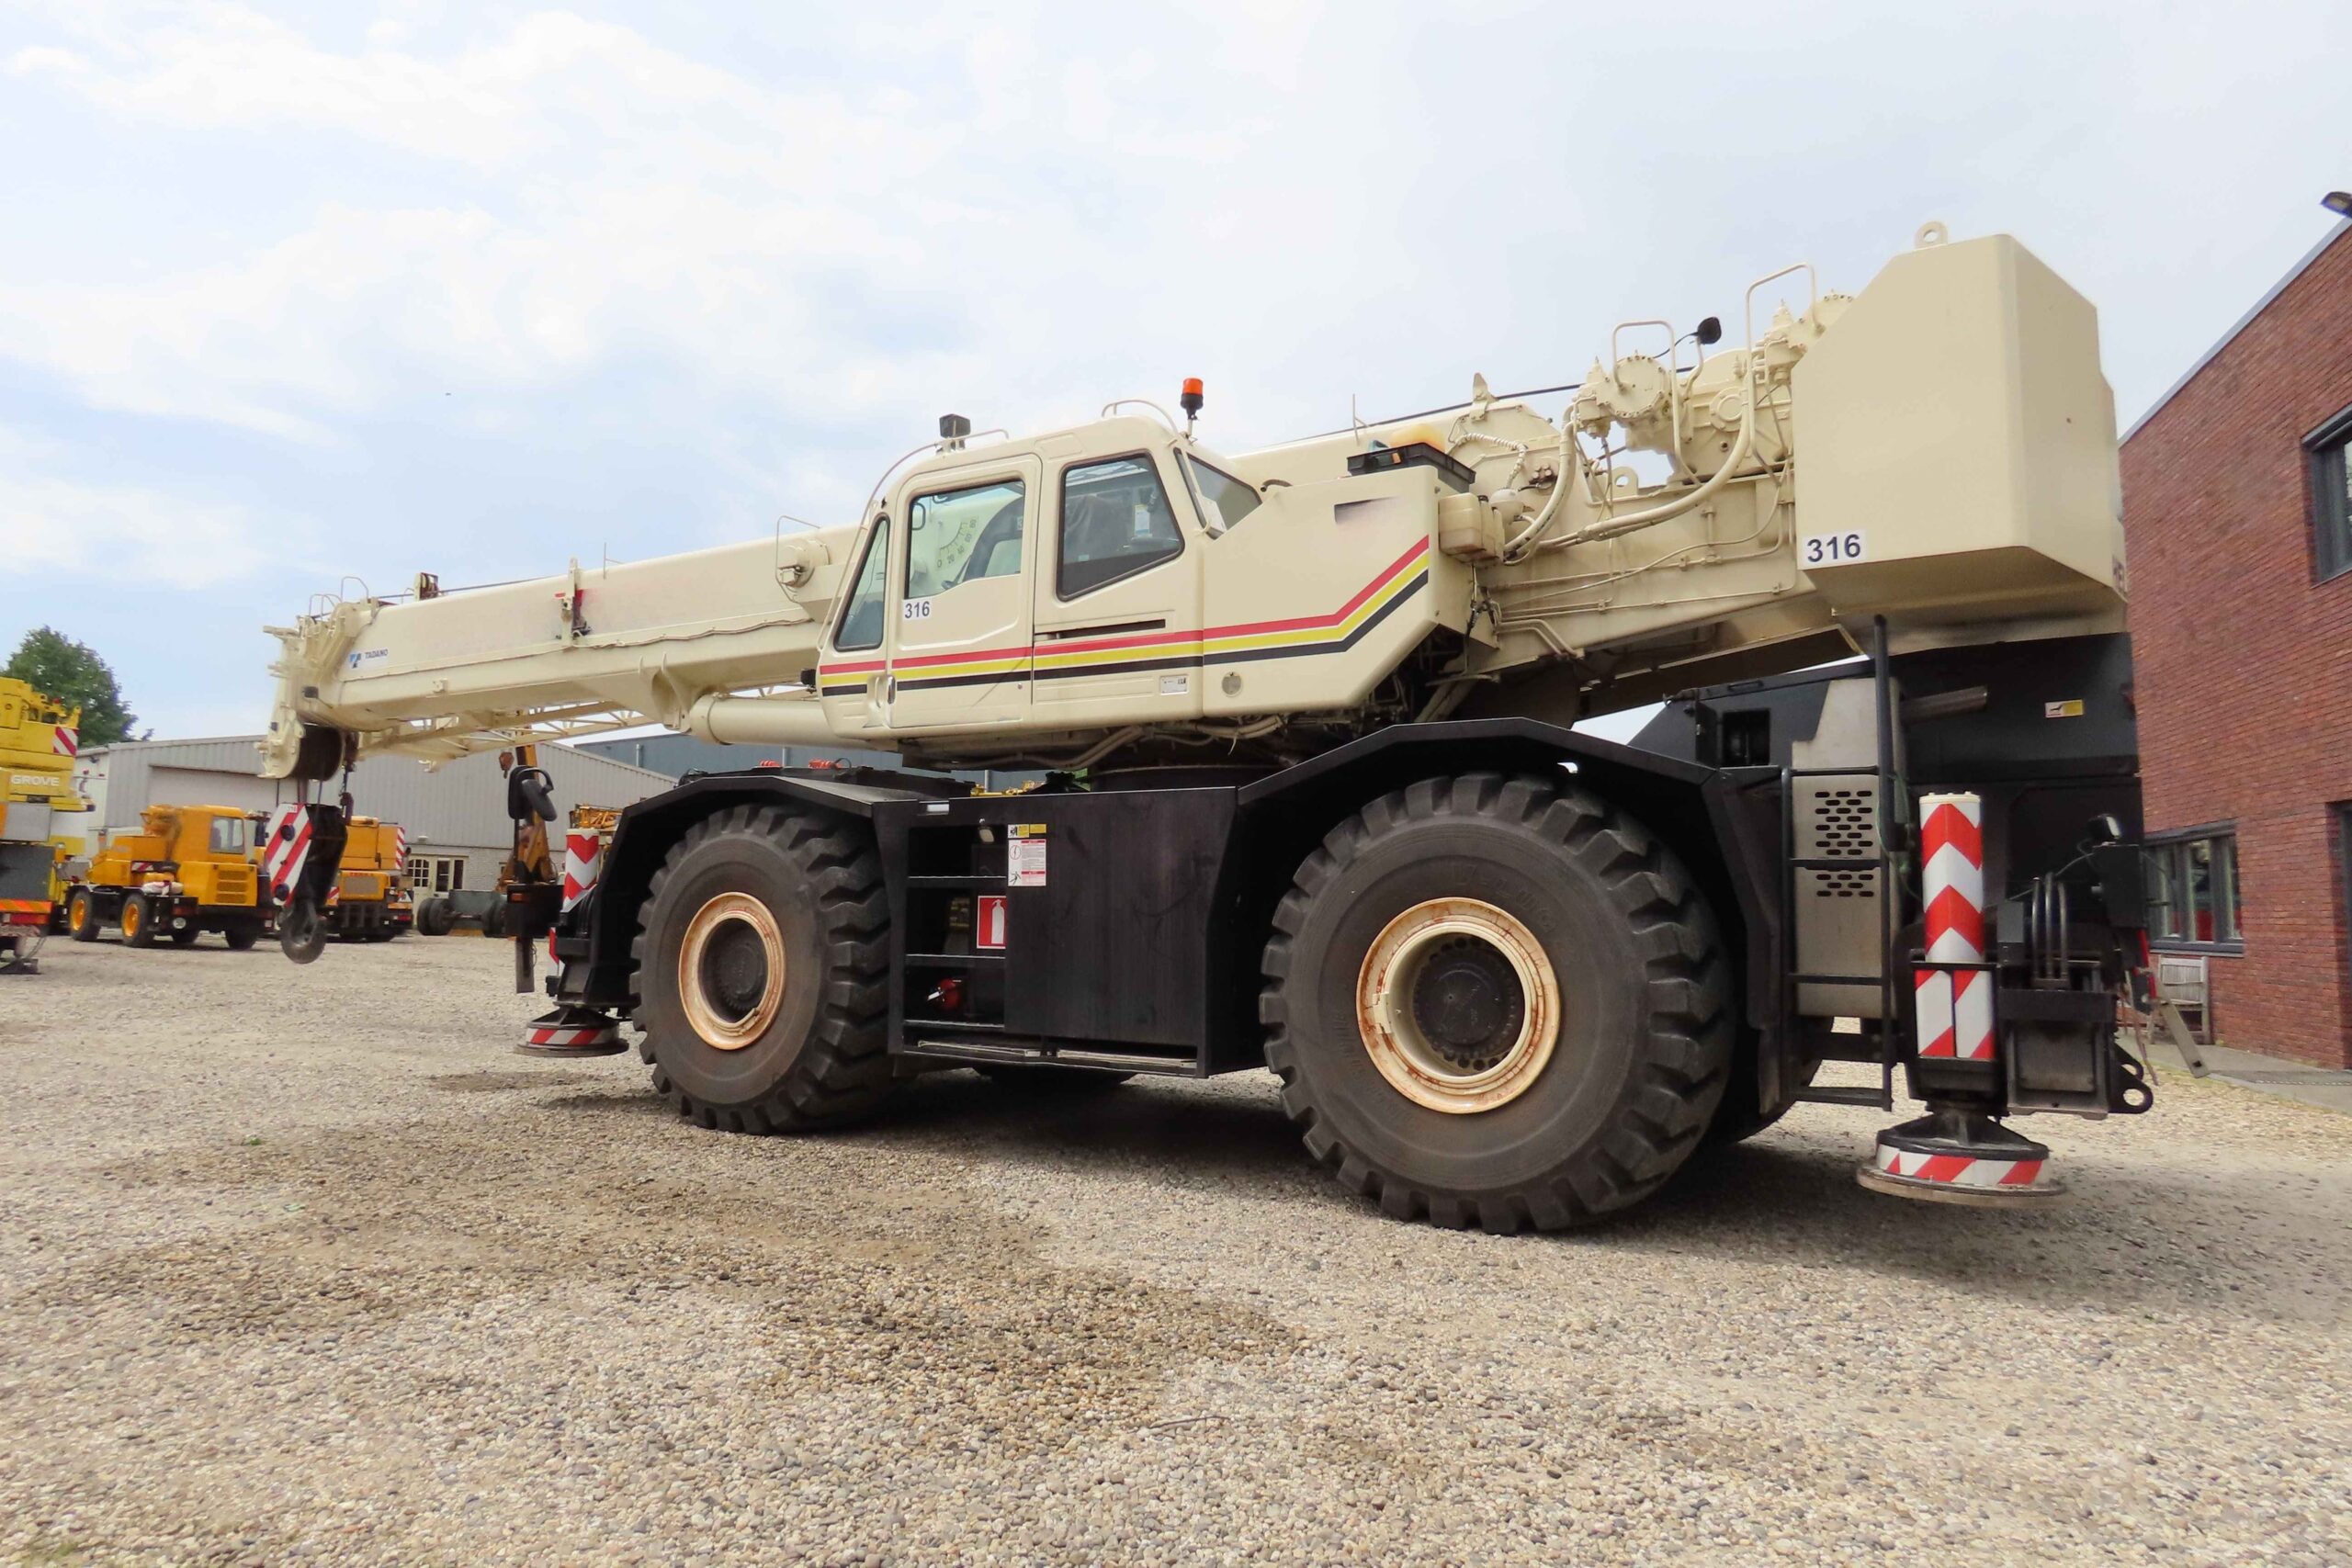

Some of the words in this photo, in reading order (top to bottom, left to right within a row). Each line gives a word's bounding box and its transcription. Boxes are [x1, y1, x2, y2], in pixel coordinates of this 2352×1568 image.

[1807, 534, 1861, 563] 316
[904, 601, 931, 619] 316
[365, 649, 389, 659] TADANO
[10, 774, 60, 786] GROVE
